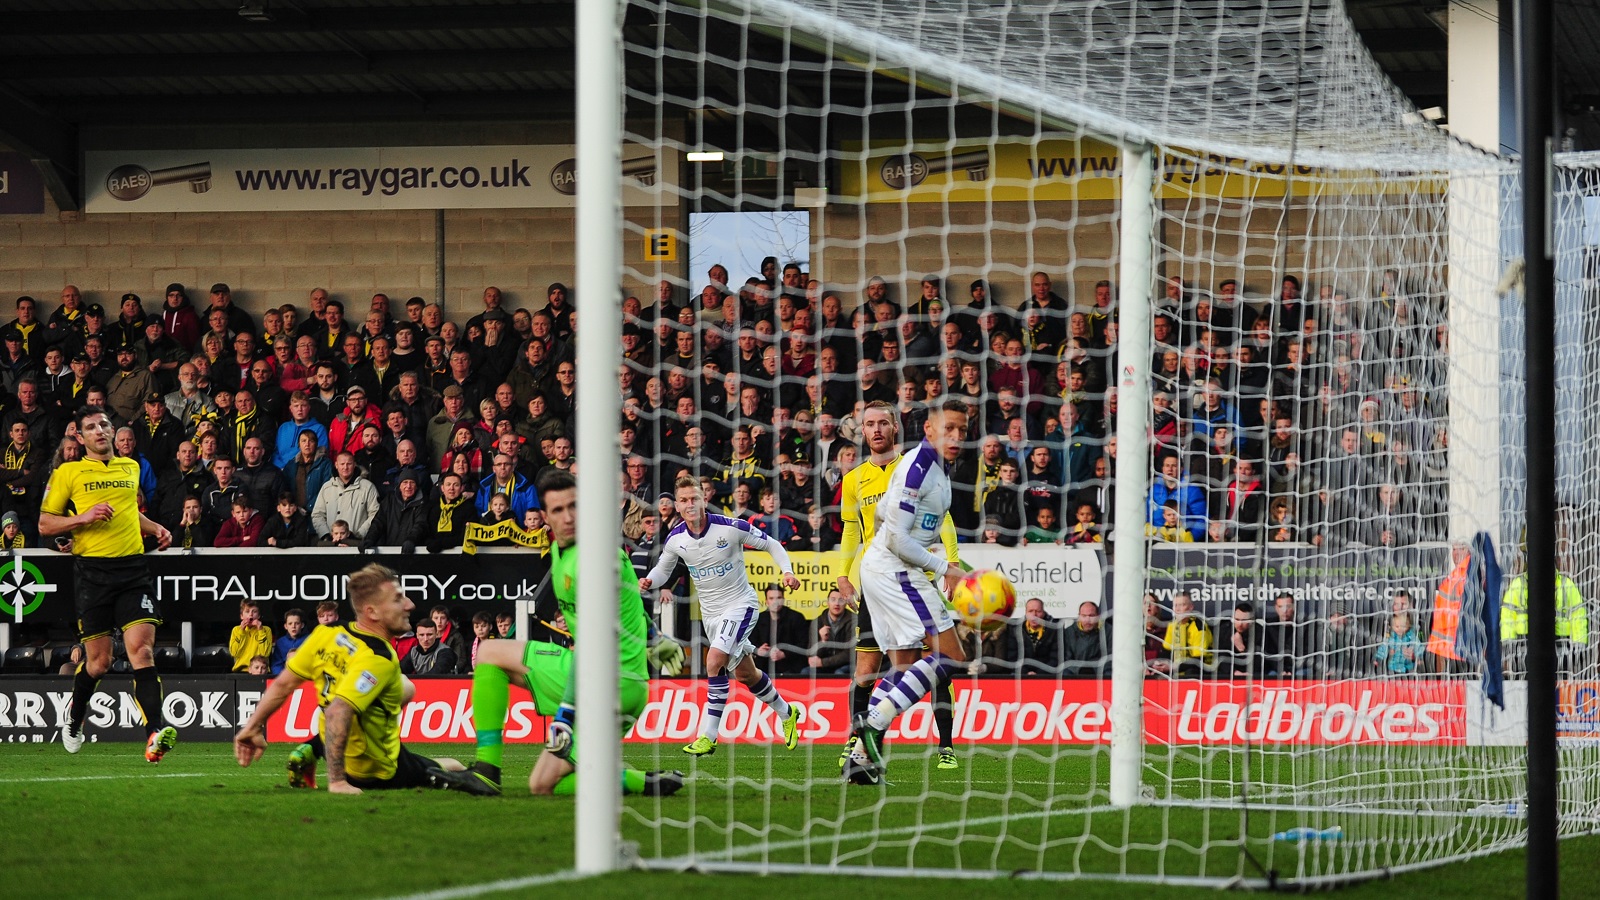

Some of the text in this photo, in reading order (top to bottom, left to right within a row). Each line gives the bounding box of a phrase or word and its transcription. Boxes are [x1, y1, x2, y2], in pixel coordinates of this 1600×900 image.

[235, 158, 531, 196] www.raygar.co.uk
[884, 162, 923, 181] RAES
[110, 173, 148, 191] RAES
[651, 234, 669, 256] E
[83, 480, 135, 492] TEMPOBET
[473, 525, 538, 545] The Brewers
[779, 562, 830, 575] lbion
[801, 579, 839, 592] Trus
[141, 594, 154, 614] 4
[719, 619, 738, 638] 11
[285, 689, 537, 739] Lroks
[883, 689, 1113, 741] adbroke
[1177, 690, 1444, 741] Ladbrokes
